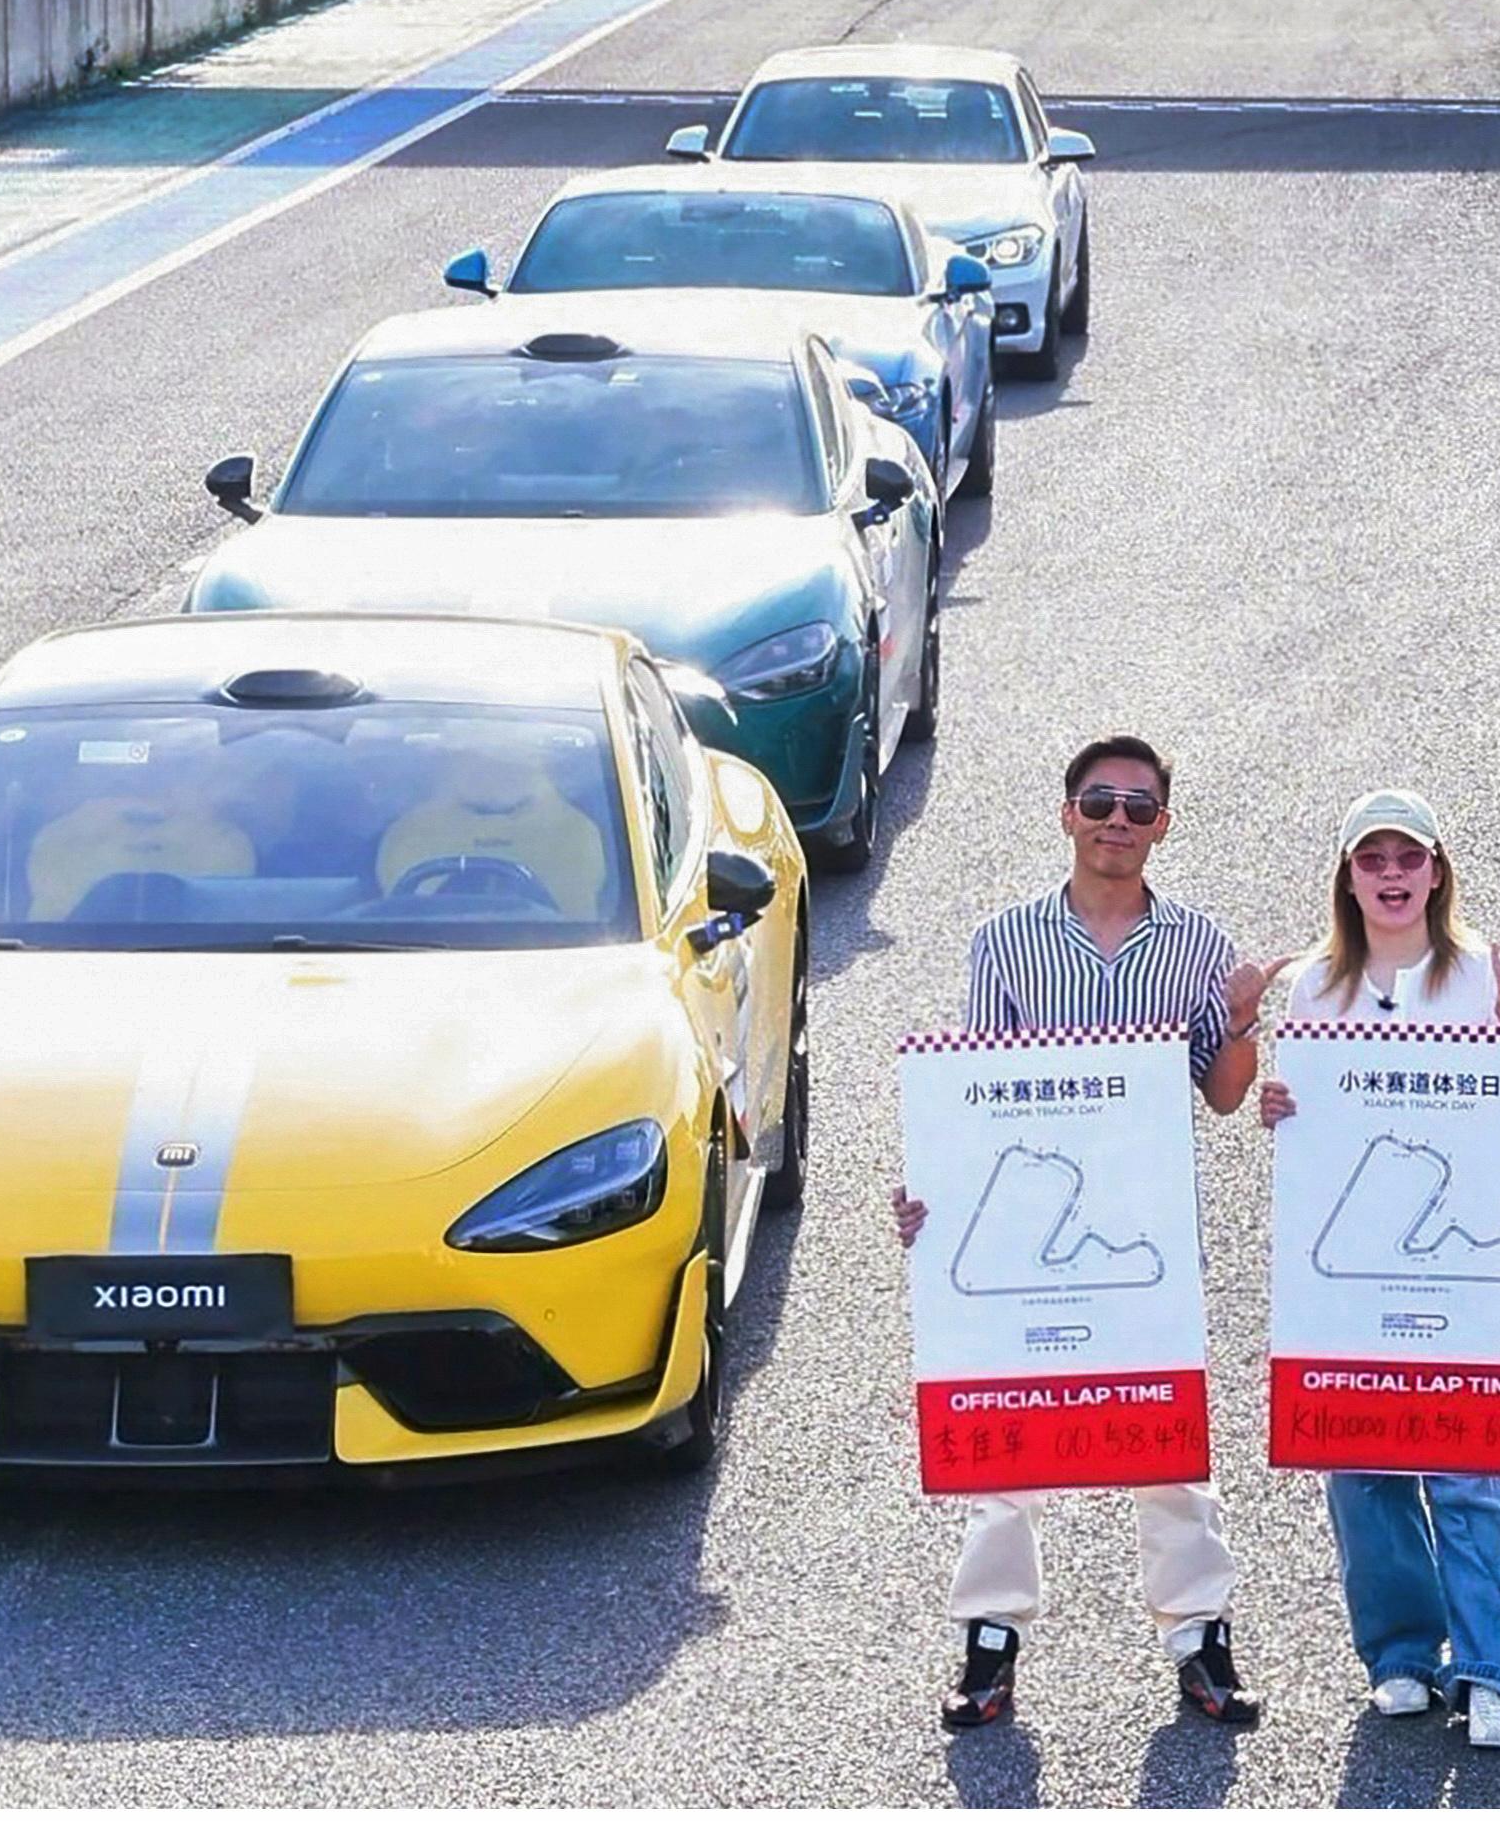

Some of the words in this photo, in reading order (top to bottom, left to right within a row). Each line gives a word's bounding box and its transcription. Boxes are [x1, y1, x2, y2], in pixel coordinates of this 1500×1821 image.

[964, 1075, 1127, 1105] 小米赛道体验日
[1338, 1069, 1500, 1097] 小米赛道体验日
[1303, 1370, 1411, 1392] OFFICIAL
[1416, 1374, 1464, 1393] LAP
[950, 1389, 1059, 1412] OFFICIAL
[1063, 1386, 1112, 1406] LAP
[1115, 1383, 1174, 1403] TIME
